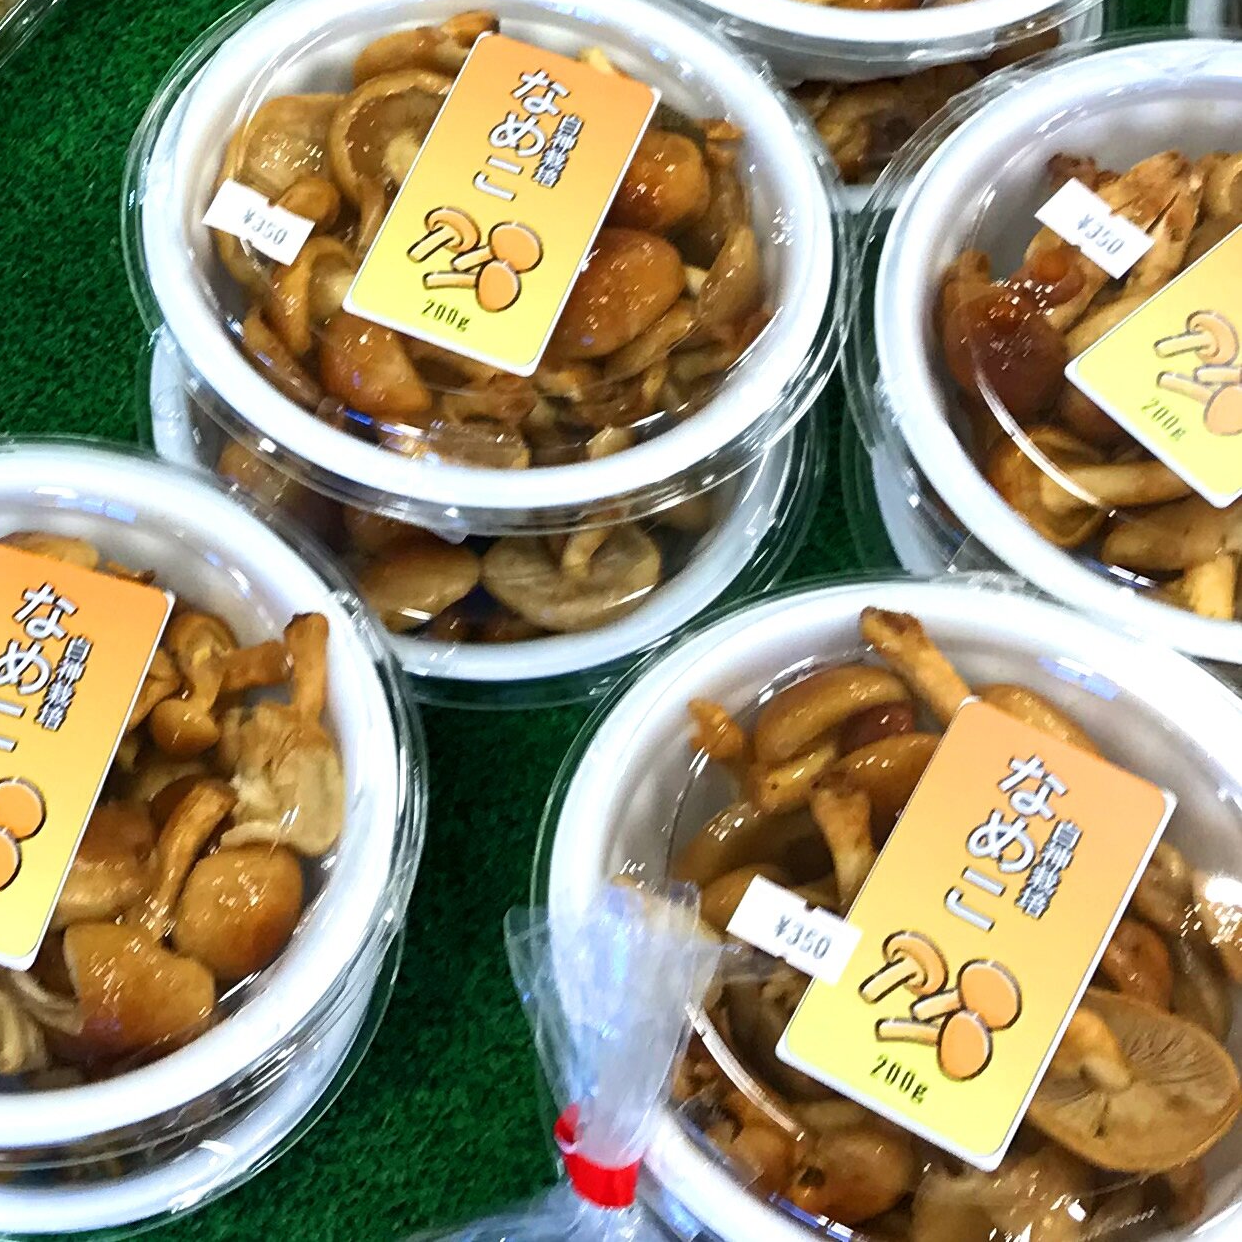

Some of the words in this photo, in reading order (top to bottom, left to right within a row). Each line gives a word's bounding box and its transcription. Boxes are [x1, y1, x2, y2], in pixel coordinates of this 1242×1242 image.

[473, 69, 571, 201] なめこ
[242, 208, 289, 246] ¥350
[1077, 214, 1125, 255] ¥350
[421, 299, 471, 332] 200g
[1141, 397, 1186, 442] 200g
[944, 754, 1068, 933] なめこ
[775, 915, 832, 959] ¥350
[870, 1054, 929, 1104] 200g
